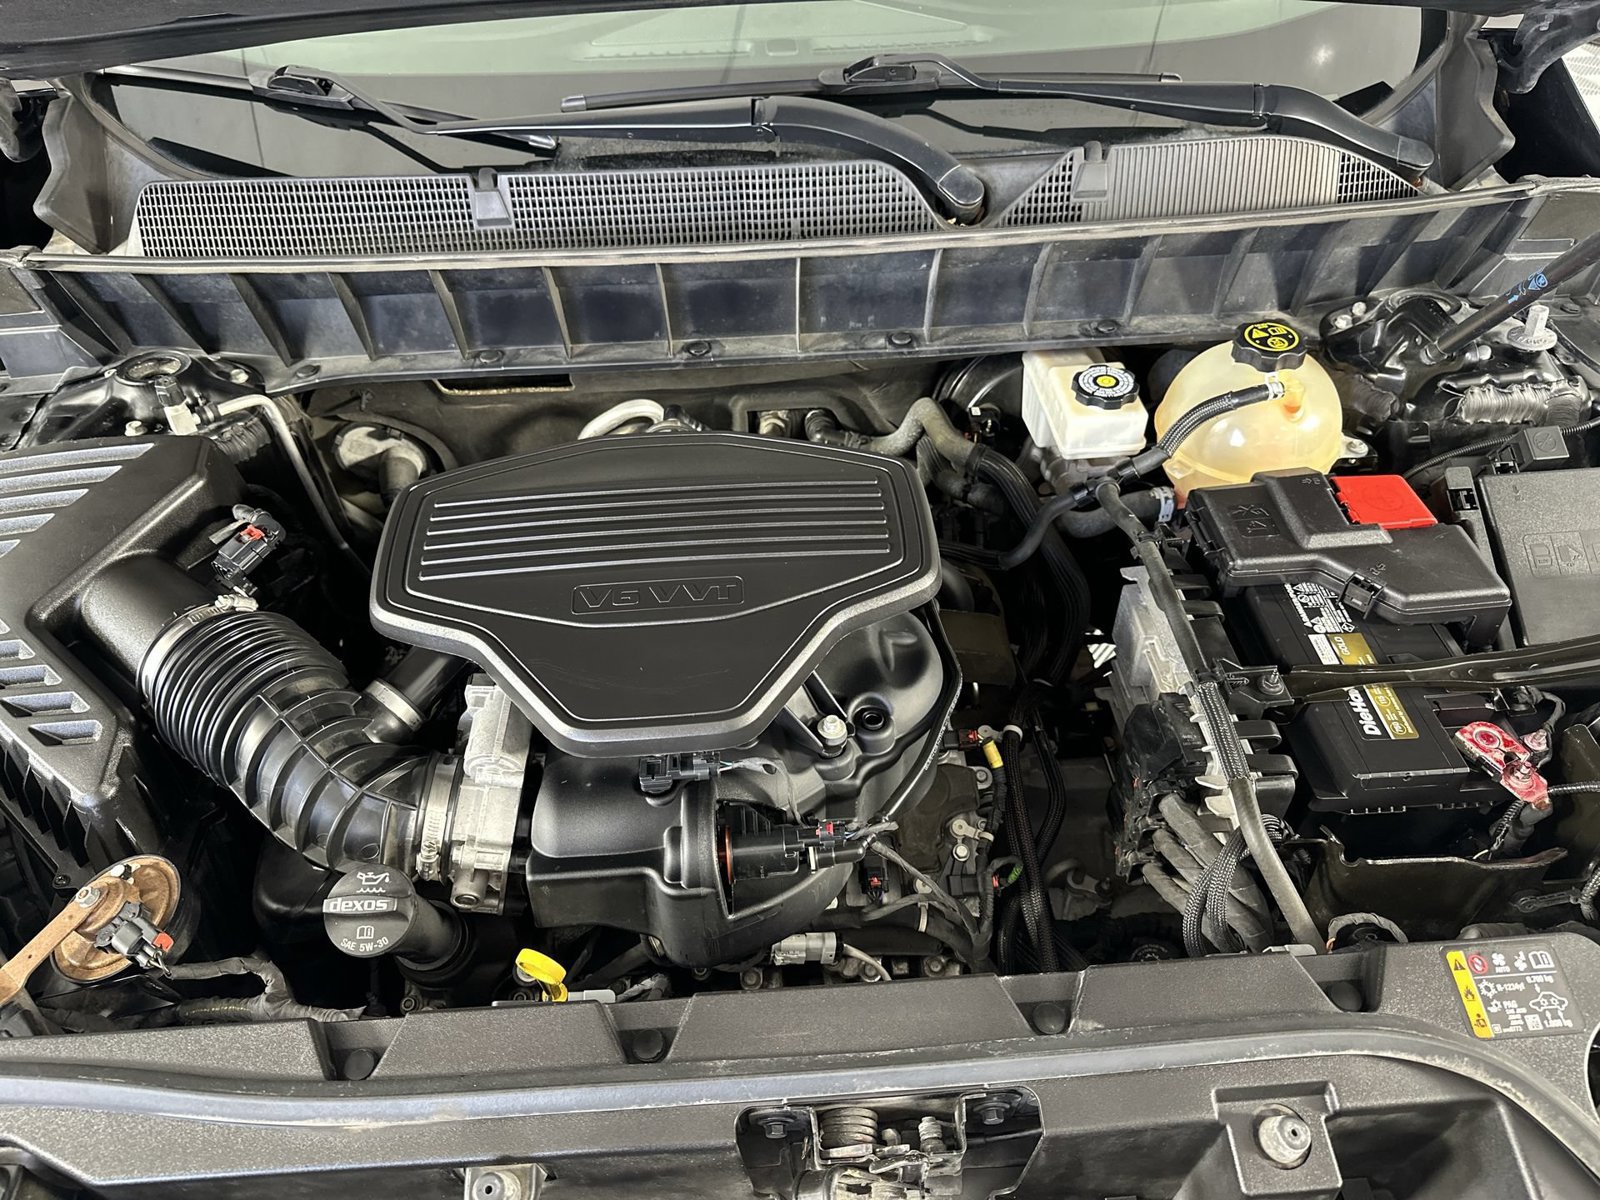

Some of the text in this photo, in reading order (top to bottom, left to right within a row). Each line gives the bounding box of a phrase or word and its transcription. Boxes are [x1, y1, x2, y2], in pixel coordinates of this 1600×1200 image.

[579, 584, 737, 607] V6 VVT
[1334, 636, 1351, 656] GOLD
[1348, 687, 1382, 735] DieHa
[329, 897, 389, 912] dexos
[340, 936, 389, 952] SAE 5W-30
